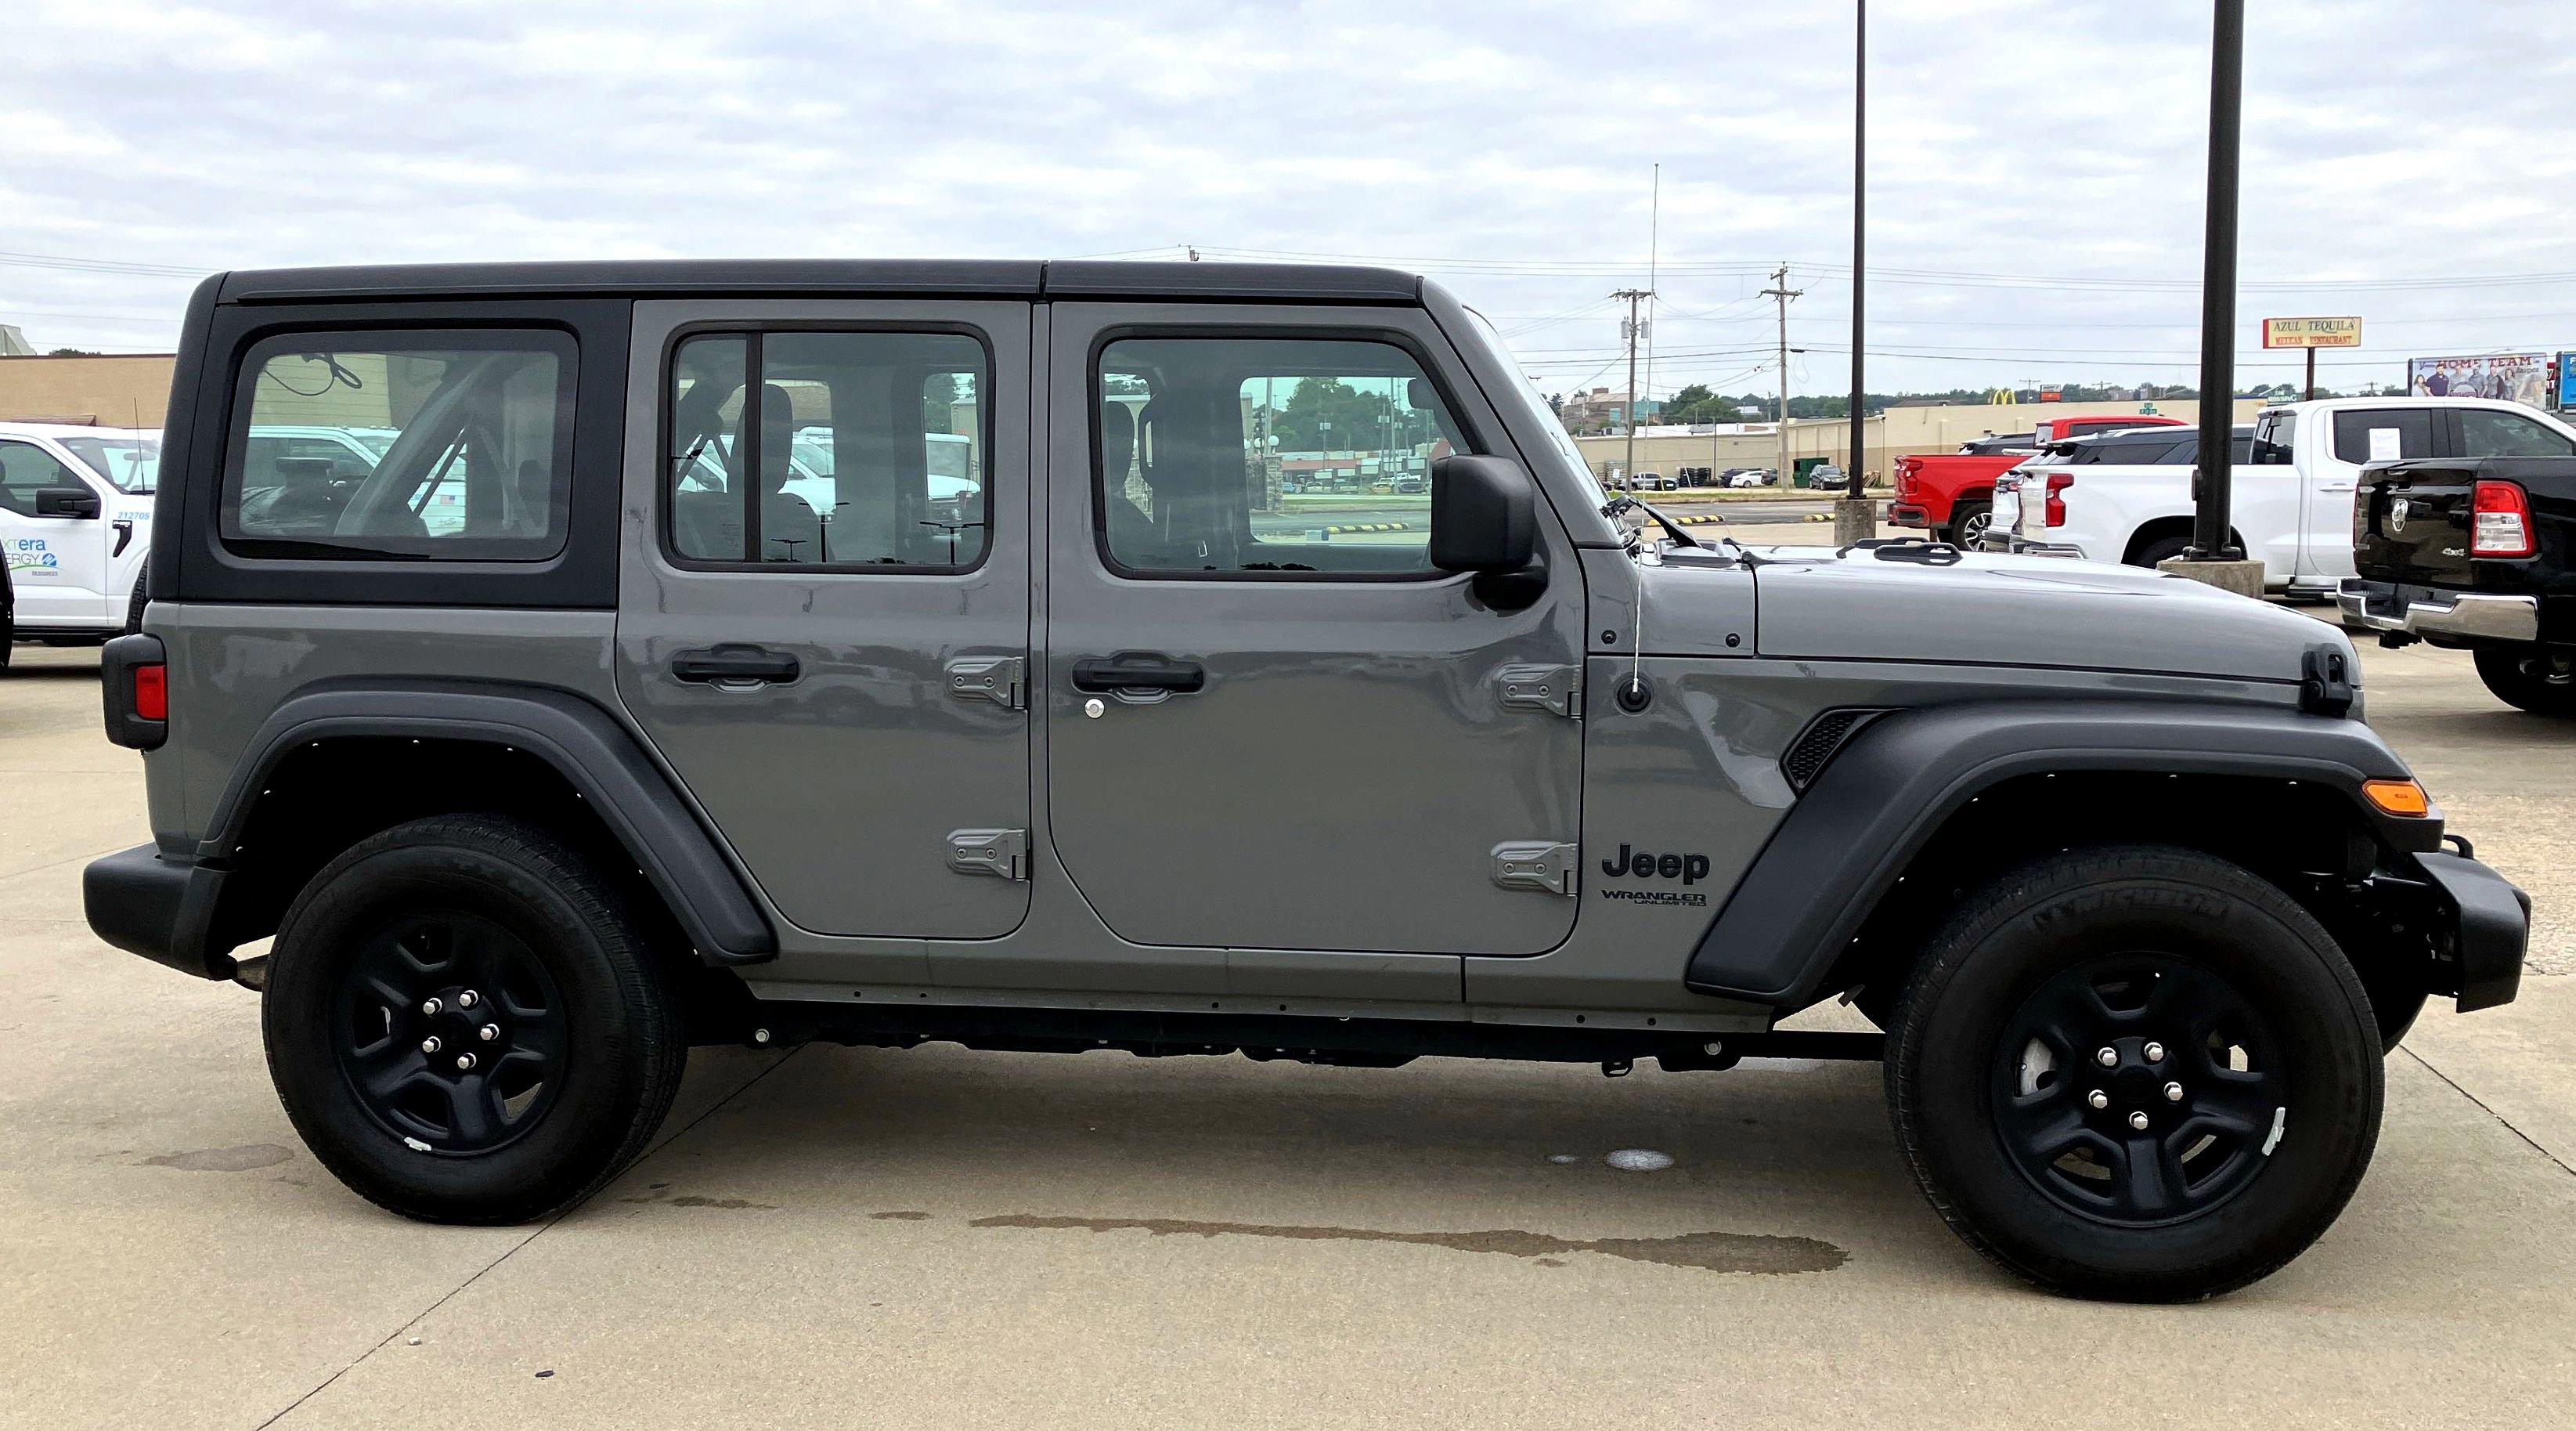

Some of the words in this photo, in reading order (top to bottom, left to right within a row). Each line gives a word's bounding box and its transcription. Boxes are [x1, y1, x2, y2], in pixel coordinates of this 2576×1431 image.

[2274, 321, 2301, 331] AZUL
[2308, 320, 2355, 334] TEQUILA
[2437, 359, 2480, 369] HOME
[2488, 356, 2531, 367] TEAM
[117, 511, 150, 520] 212705
[5, 553, 40, 565] ERGY
[1602, 843, 1710, 885] Jeep
[1601, 890, 1706, 902] WRANGLER
